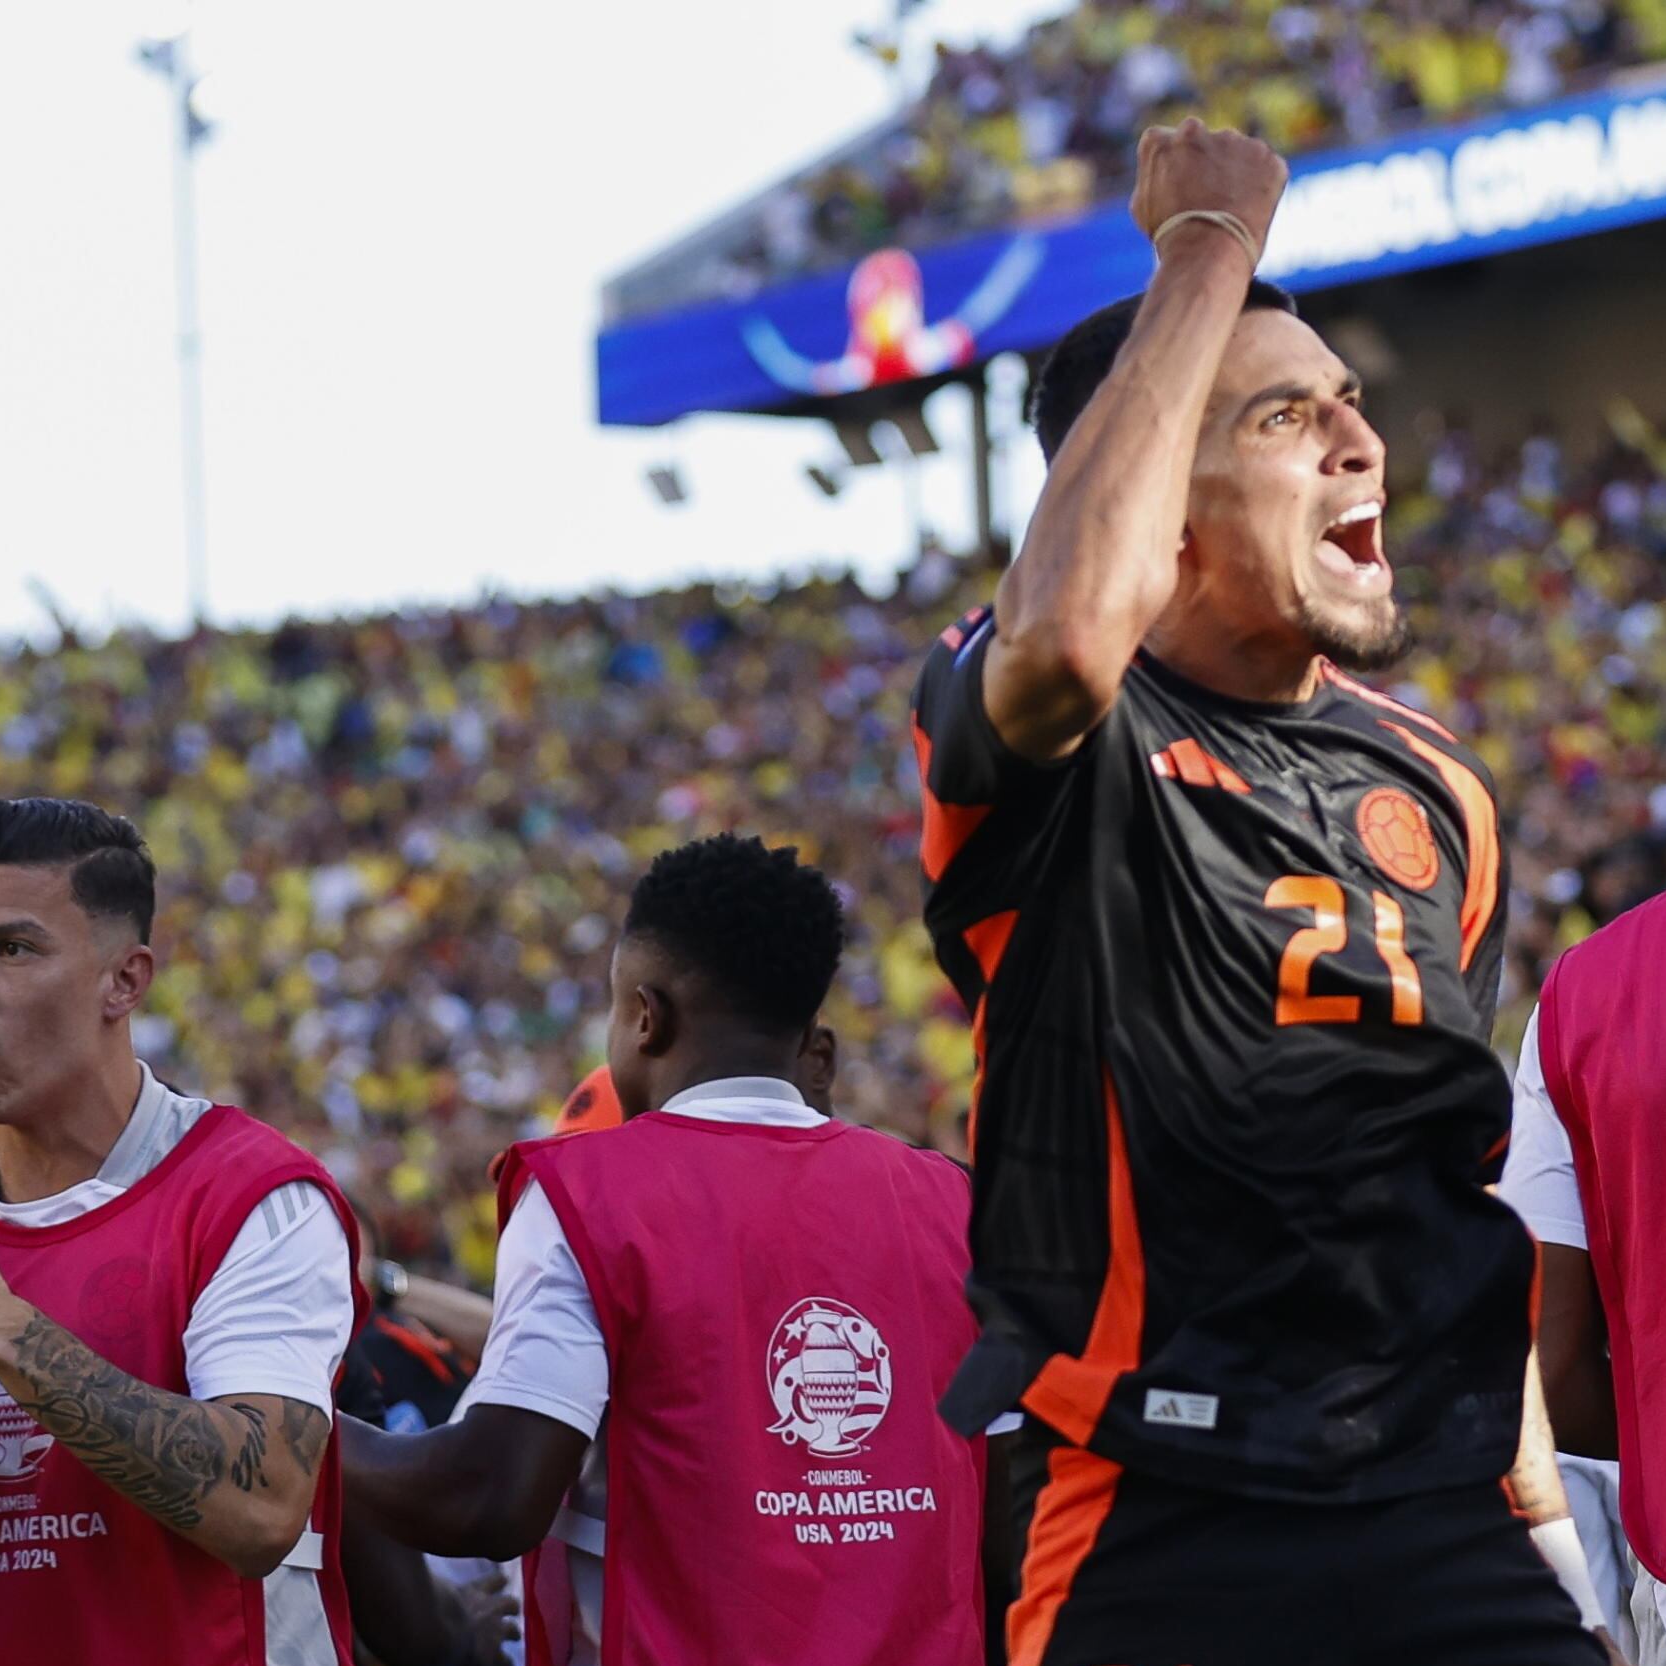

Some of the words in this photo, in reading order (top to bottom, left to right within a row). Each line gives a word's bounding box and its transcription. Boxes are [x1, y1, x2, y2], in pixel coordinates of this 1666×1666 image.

[1264, 874, 1424, 1026] 21
[755, 1491, 813, 1516] COPA
[817, 1487, 937, 1516] AMERICA
[0, 1512, 108, 1543] AMERICA
[795, 1523, 833, 1544] USA
[839, 1520, 894, 1543] 2024
[13, 1549, 57, 1569] 2024
